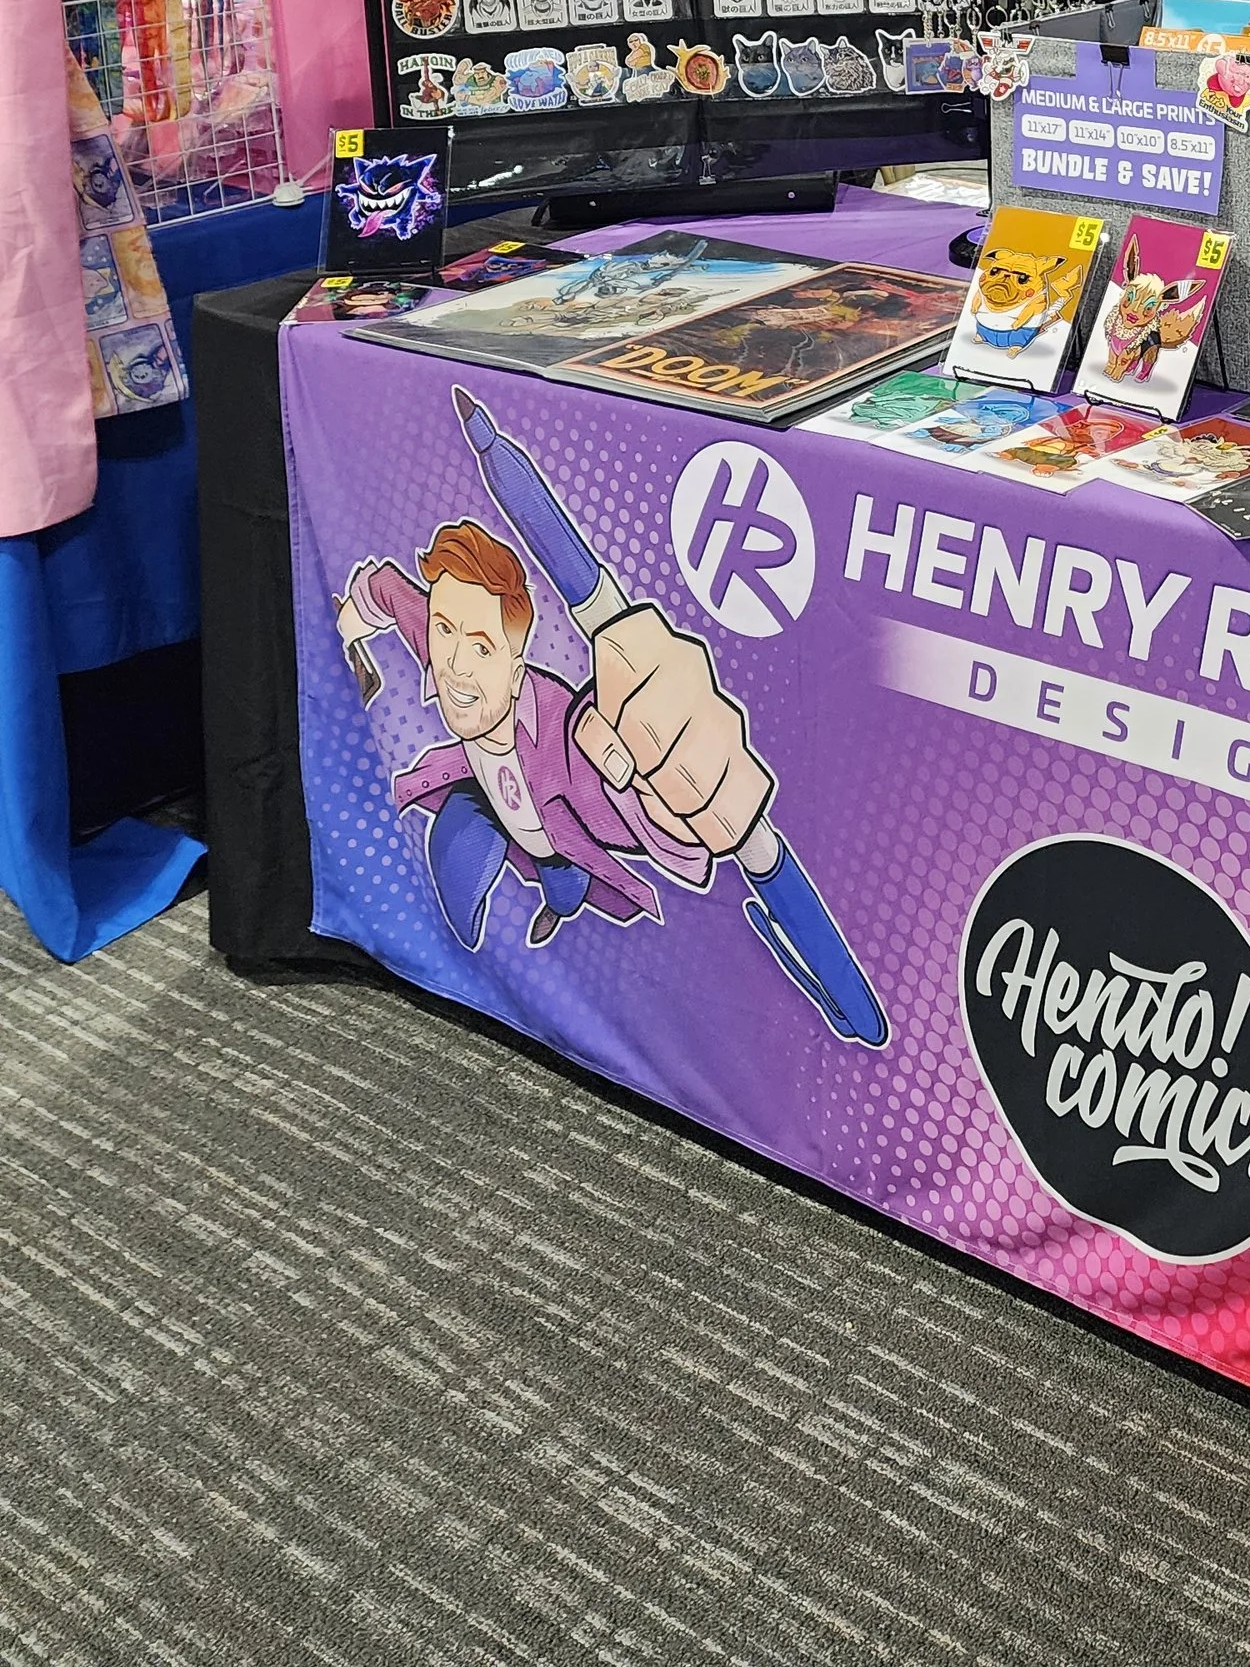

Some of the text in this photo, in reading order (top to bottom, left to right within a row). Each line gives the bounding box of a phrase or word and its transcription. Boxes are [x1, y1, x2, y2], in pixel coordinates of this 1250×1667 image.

[410, 12, 454, 36] BUSTER
[1021, 88, 1217, 126] MEDIUM & LARGE PRINTS
[1198, 98, 1245, 130] Enthusiasm
[1202, 90, 1243, 121] Kirb Your
[338, 134, 359, 154] $5
[1026, 119, 1213, 155] 11"x17" 11"x14" 10"x10" 8.5"x11"
[1021, 147, 1213, 197] BUNDLE & SAVE!
[1074, 221, 1099, 247] $5
[1201, 237, 1226, 266] $5
[843, 492, 1192, 663] HENRY
